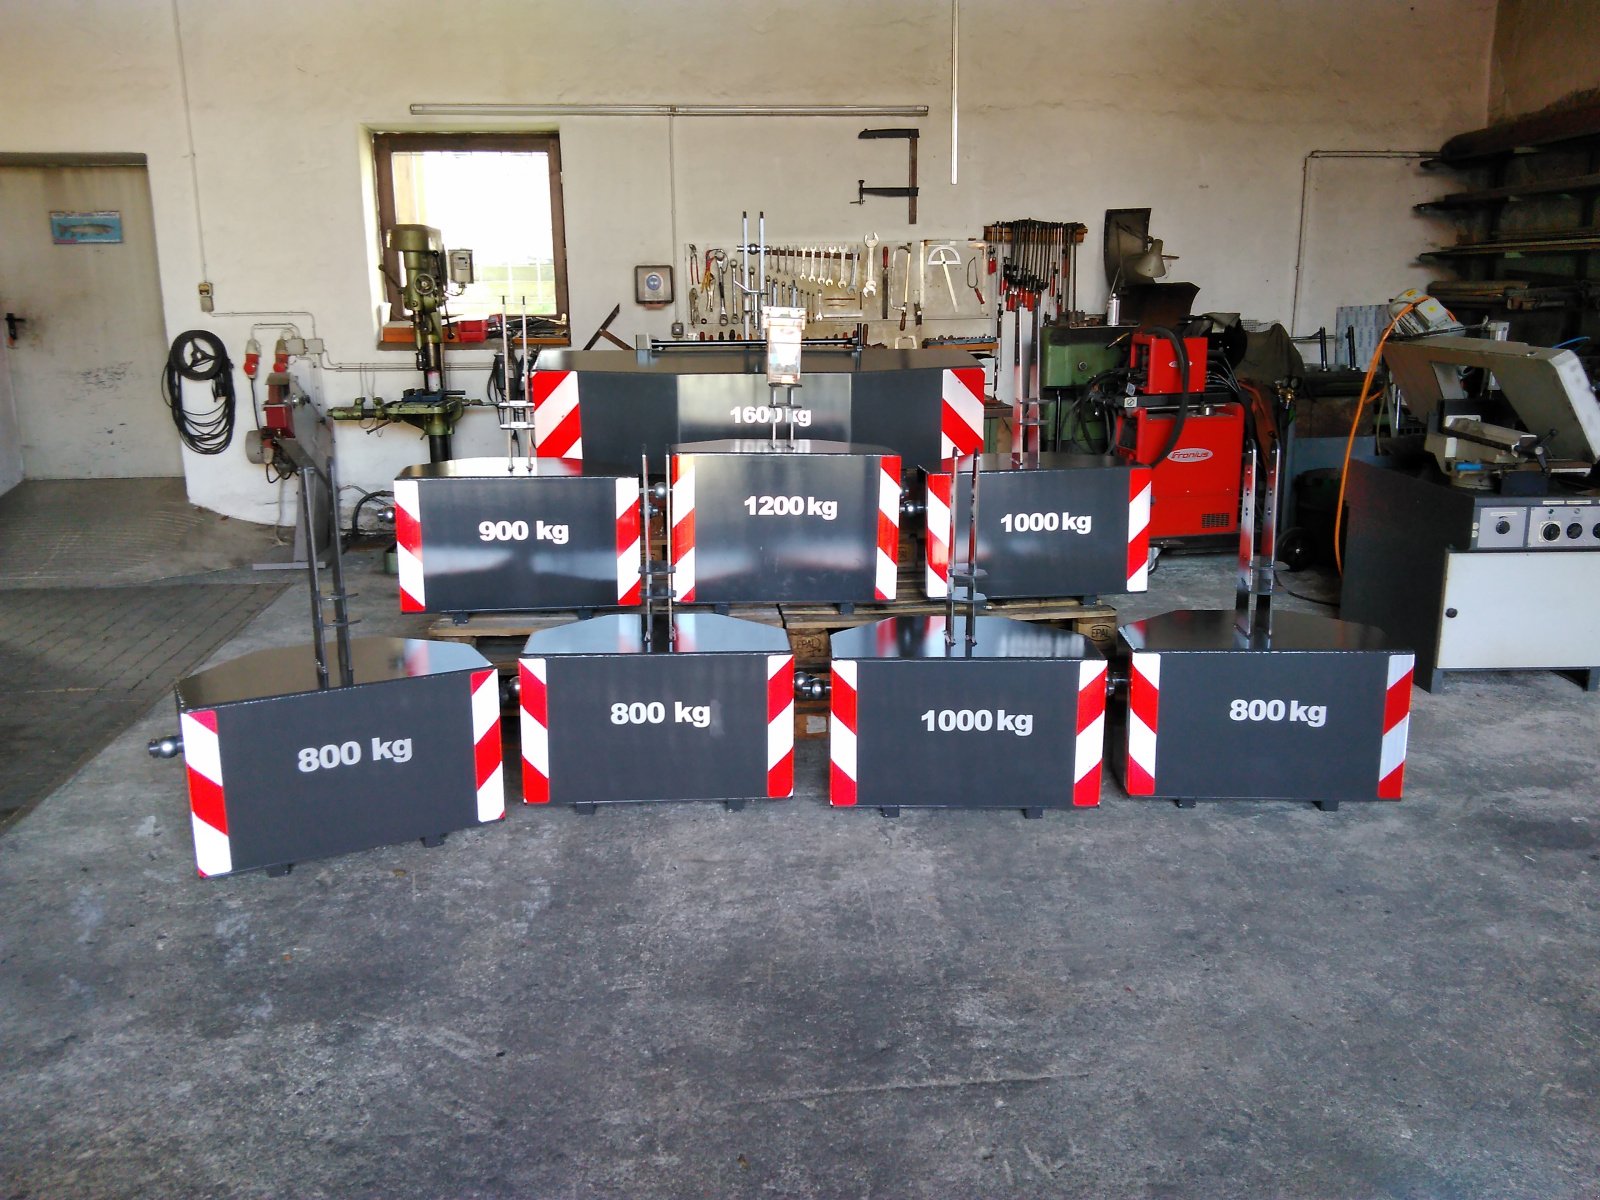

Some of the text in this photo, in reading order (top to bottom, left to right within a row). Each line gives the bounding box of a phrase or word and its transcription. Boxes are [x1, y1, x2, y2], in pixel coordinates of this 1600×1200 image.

[1171, 451, 1209, 459] Fronius
[743, 495, 838, 521] 1200 kg
[478, 520, 570, 545] 900 kg
[1000, 511, 1092, 535] 1000 kg
[1091, 627, 1110, 638] EPAL
[610, 701, 711, 728] 800 kg
[921, 709, 1034, 737] 1000 kg
[1229, 699, 1327, 728] 800 kg
[298, 737, 413, 773] 800 kg
